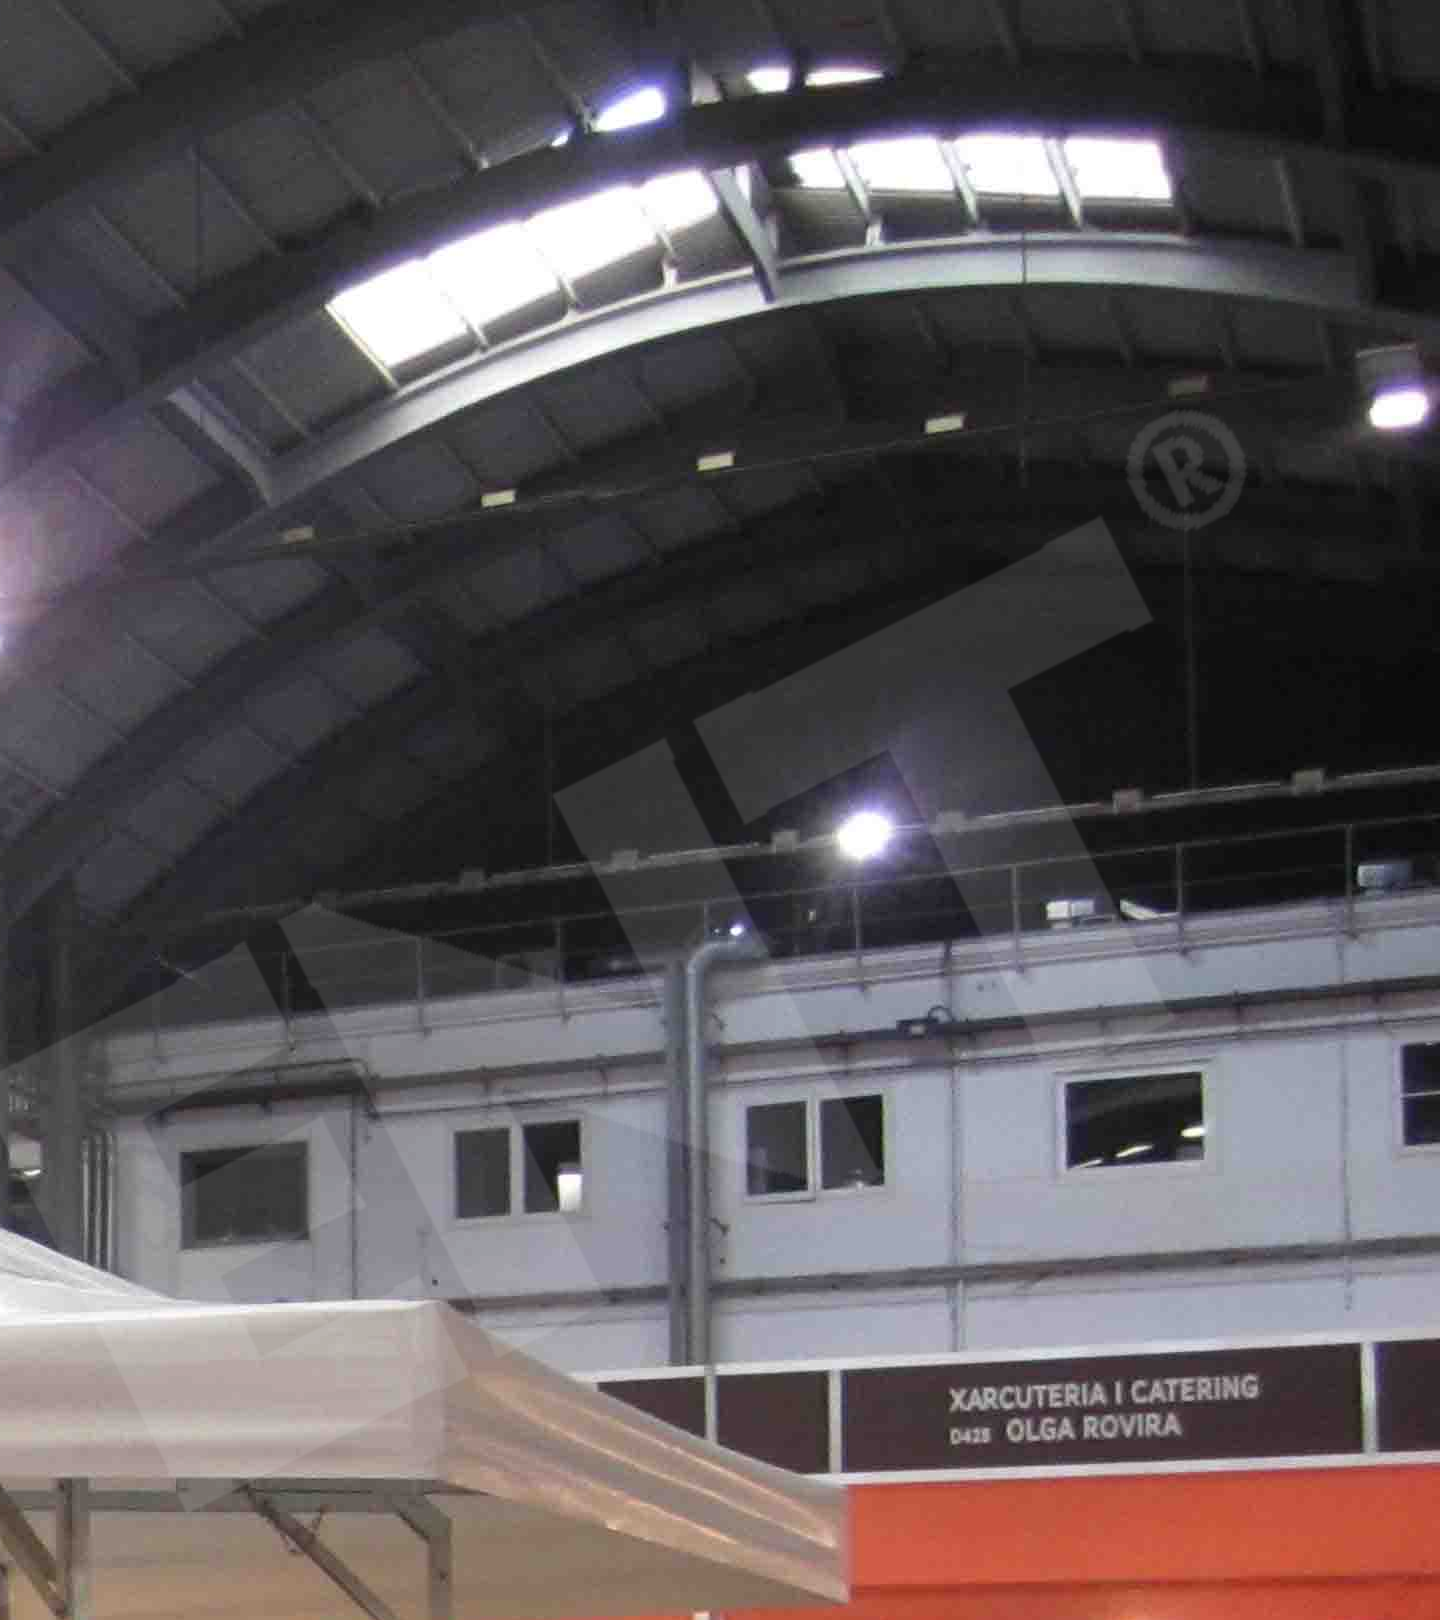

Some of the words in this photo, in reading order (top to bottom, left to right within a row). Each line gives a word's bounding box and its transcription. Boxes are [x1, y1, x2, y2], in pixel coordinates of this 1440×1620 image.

[949, 1382, 1108, 1412] XARCUTERIA
[1115, 1380, 1123, 1405] I
[1130, 1374, 1261, 1404] CATERING
[1006, 1417, 1077, 1443] OLGA
[1083, 1412, 1184, 1440] ROVIRA
